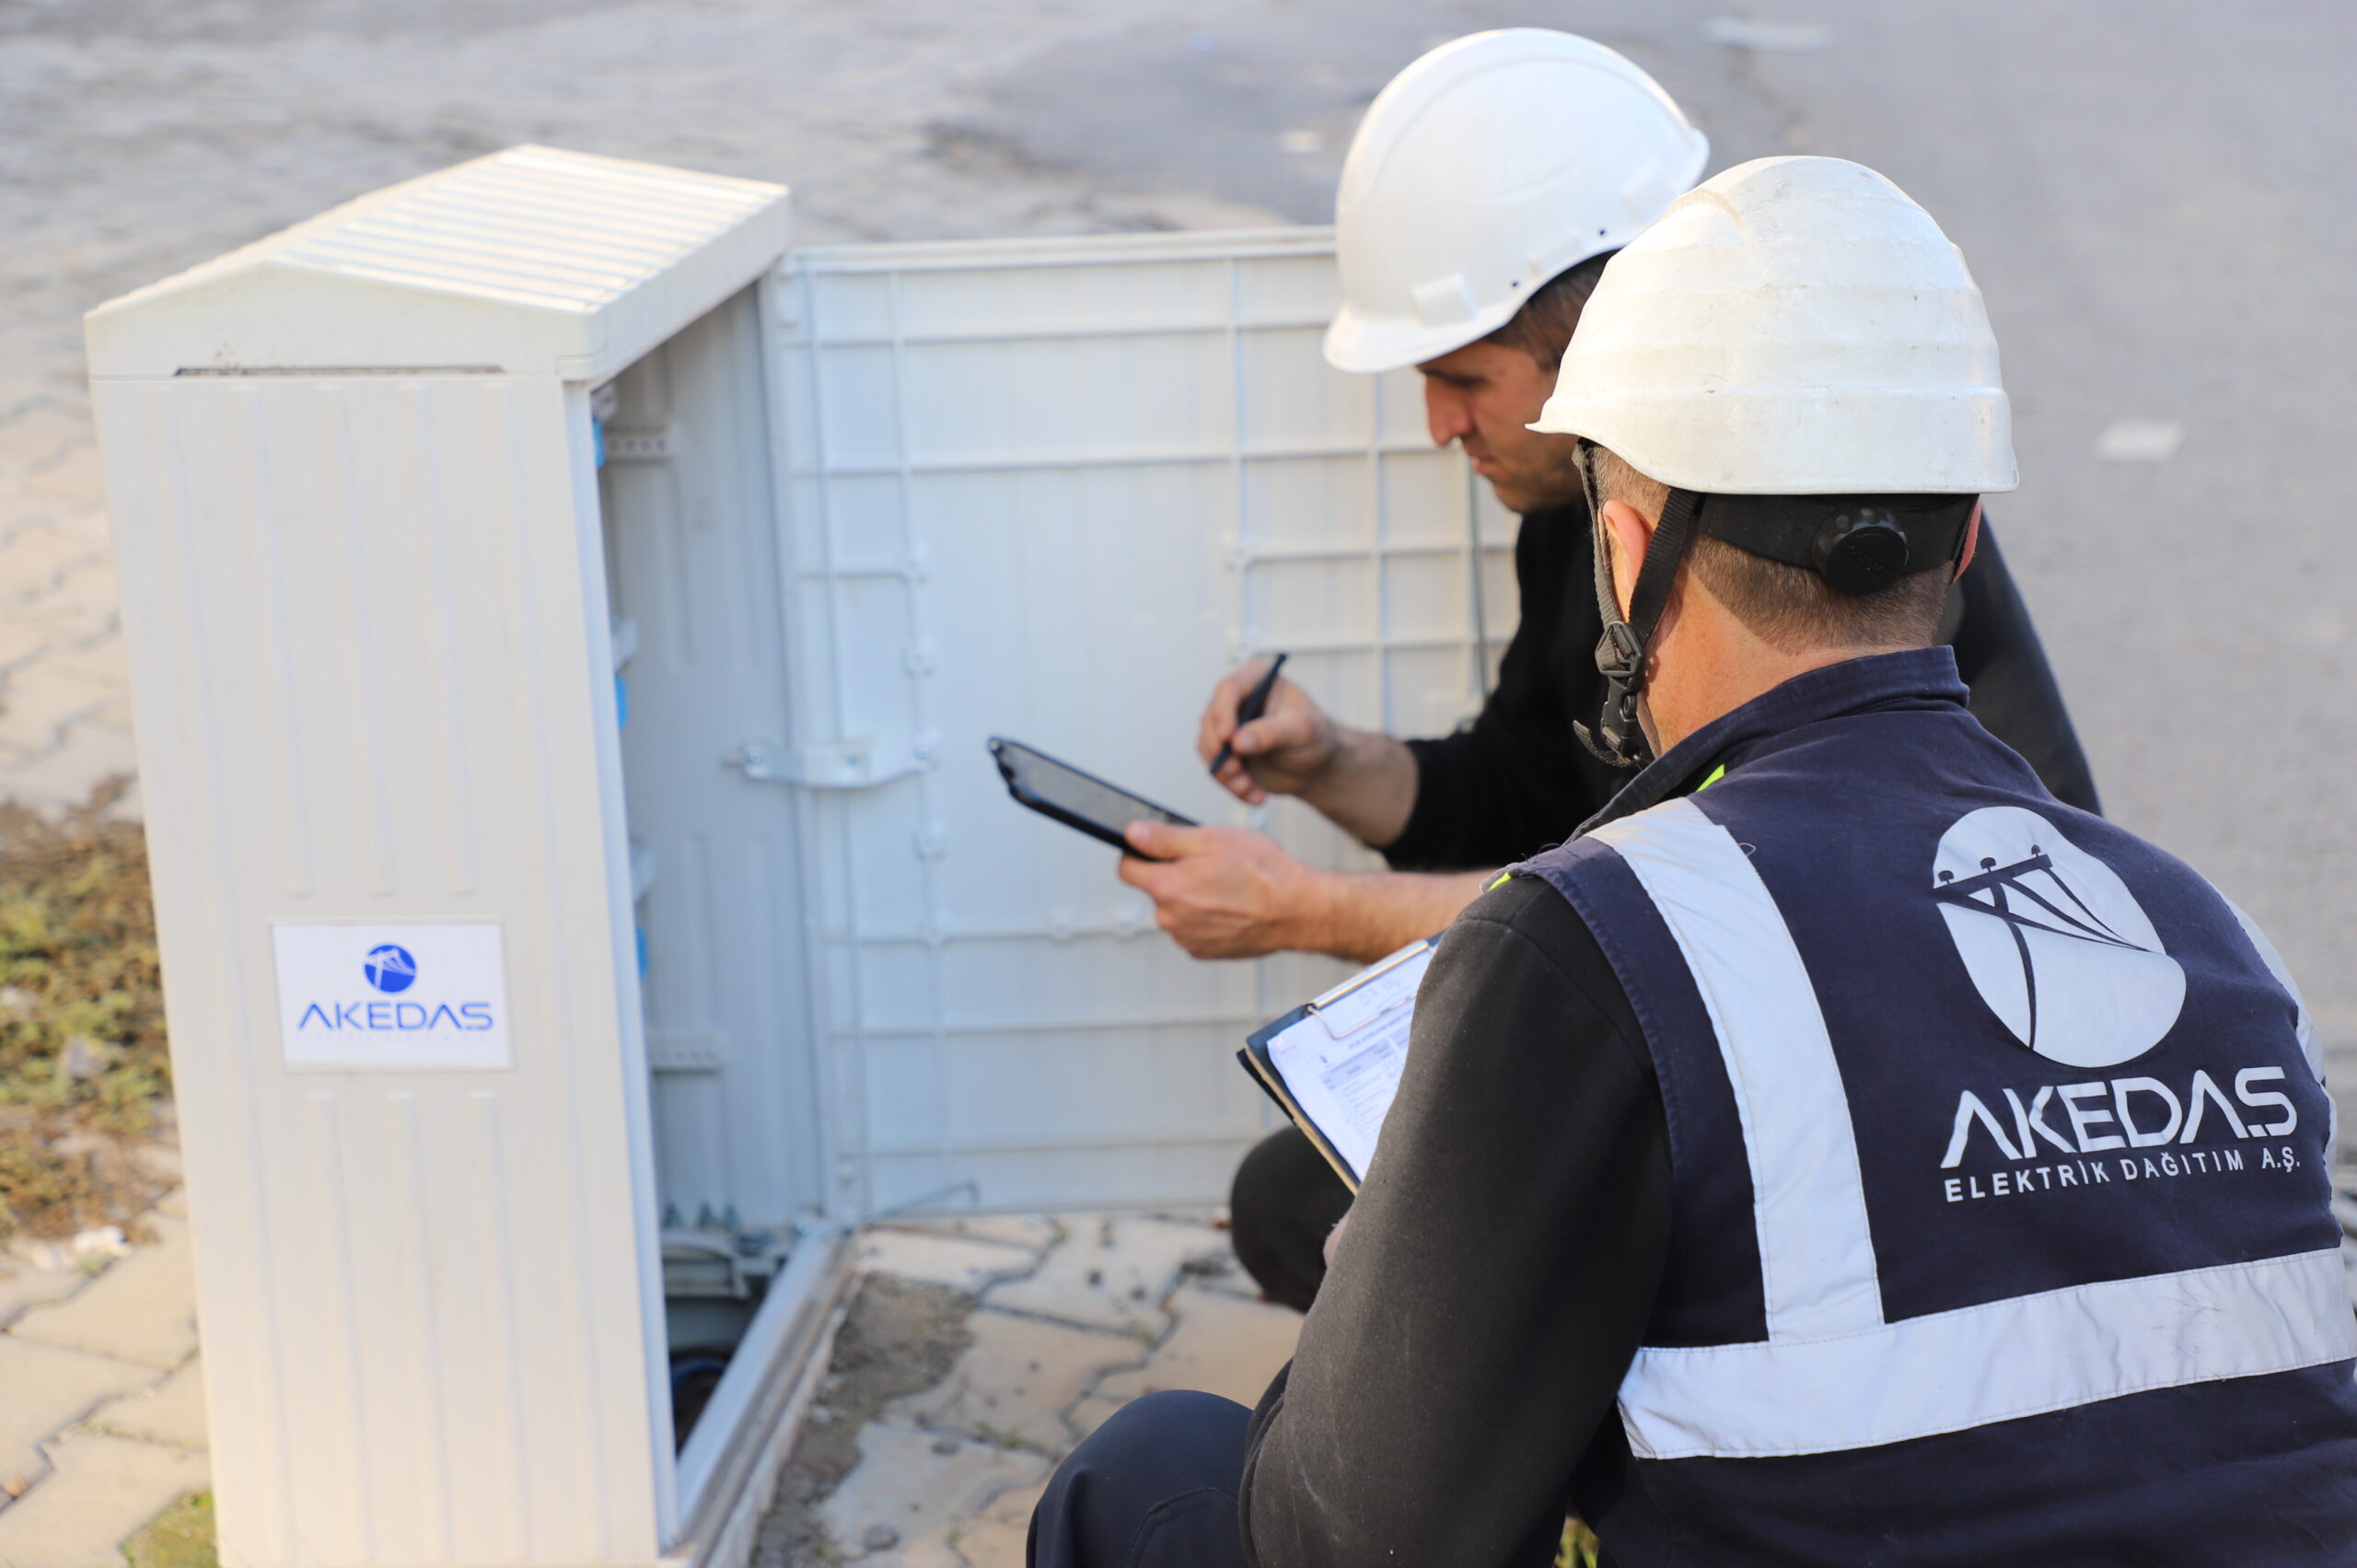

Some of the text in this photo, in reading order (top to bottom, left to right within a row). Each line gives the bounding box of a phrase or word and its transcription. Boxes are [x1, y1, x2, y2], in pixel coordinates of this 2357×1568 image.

[1944, 1145, 2302, 1202] ELEKTRİK DAĞITIM A.Ş.
